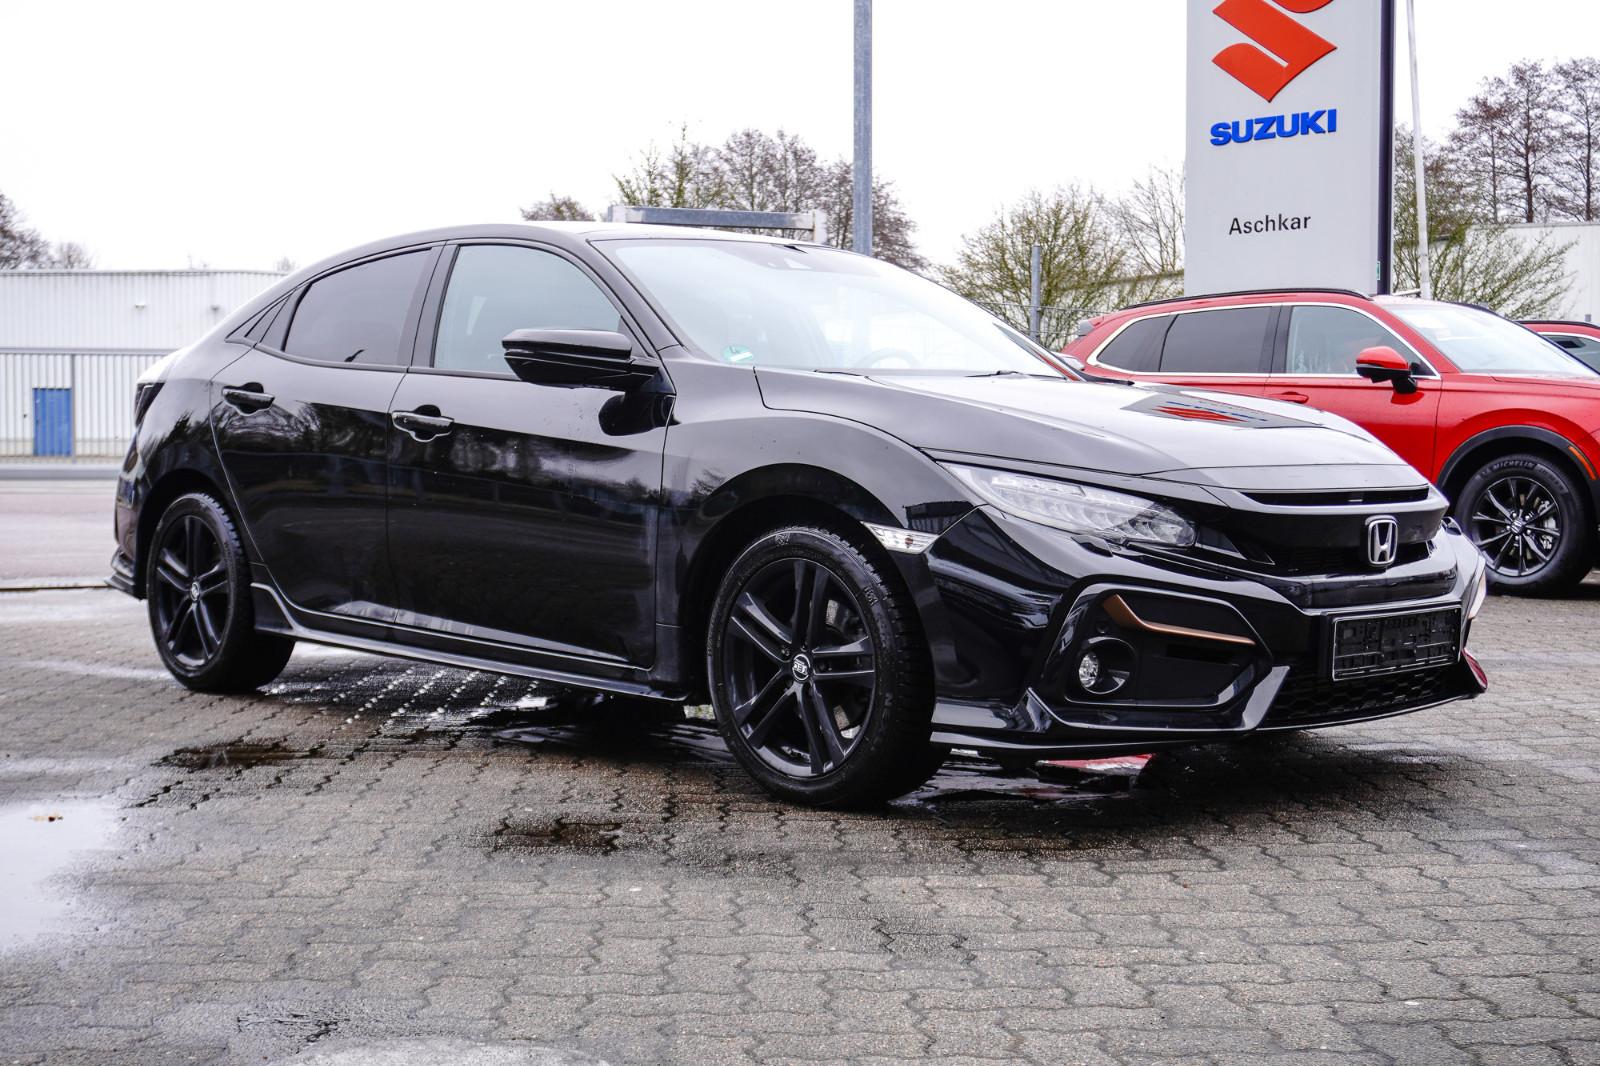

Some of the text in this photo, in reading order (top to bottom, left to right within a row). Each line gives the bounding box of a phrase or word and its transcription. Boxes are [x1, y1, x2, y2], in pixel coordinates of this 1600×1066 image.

[1210, 109, 1337, 146] SUZUKI
[1228, 214, 1312, 235] Aschkar
[1492, 460, 1536, 472] MICHELIN
